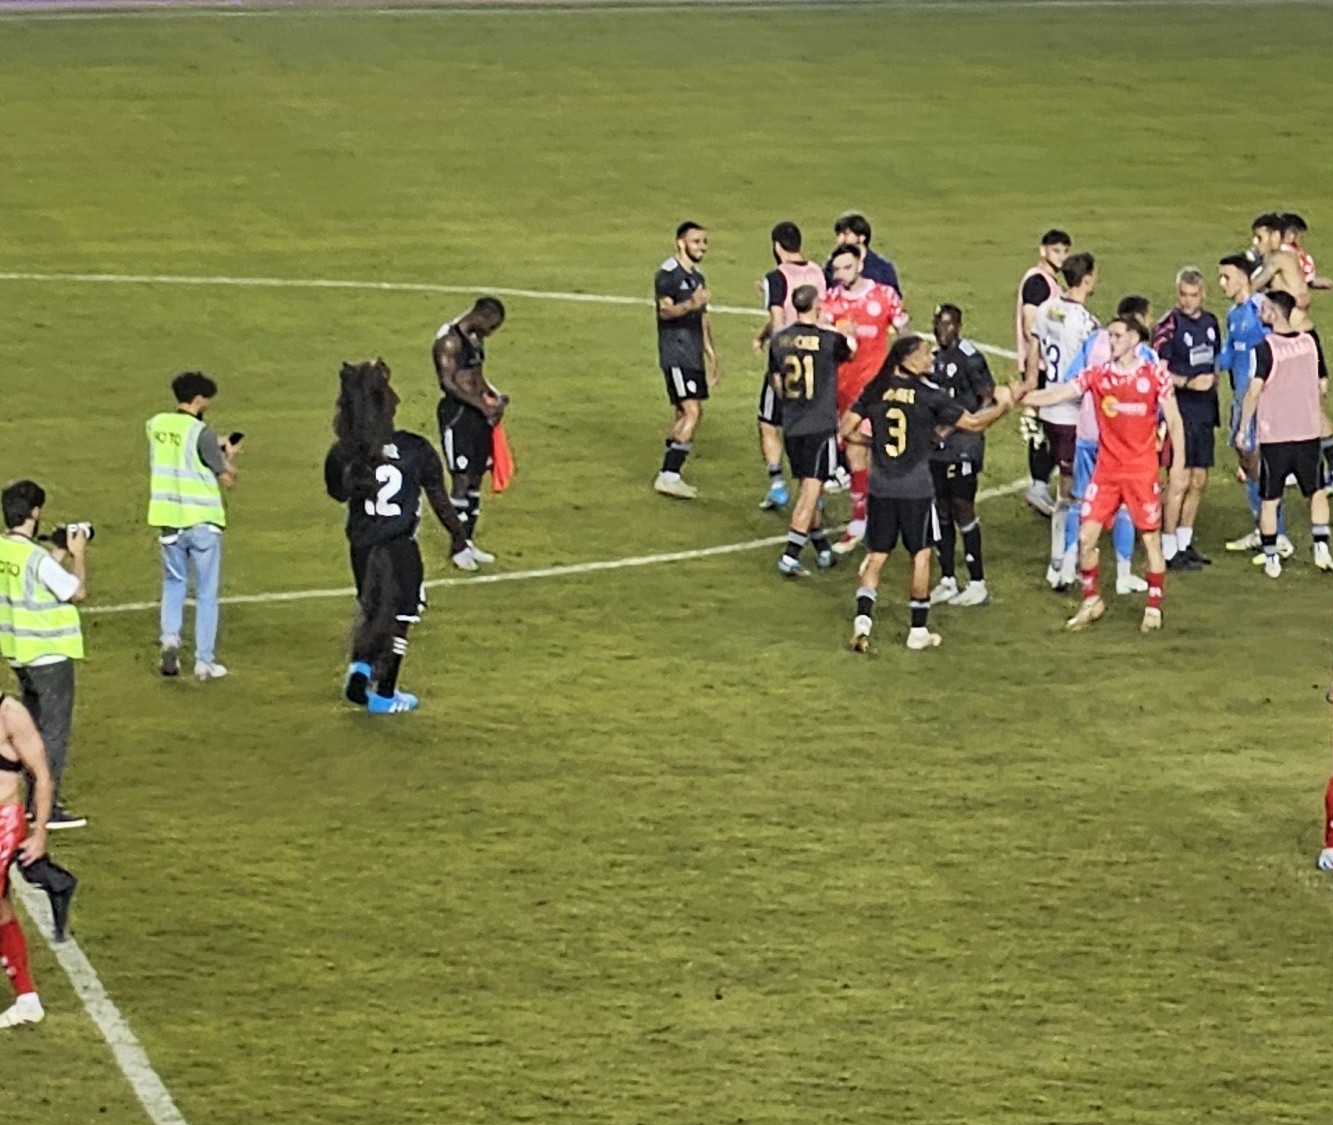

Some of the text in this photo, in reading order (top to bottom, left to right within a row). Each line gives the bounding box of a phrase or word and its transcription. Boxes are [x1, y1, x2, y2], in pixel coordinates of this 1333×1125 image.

[784, 354, 815, 400] 21
[884, 407, 907, 457] 3
[364, 464, 402, 516] 2
